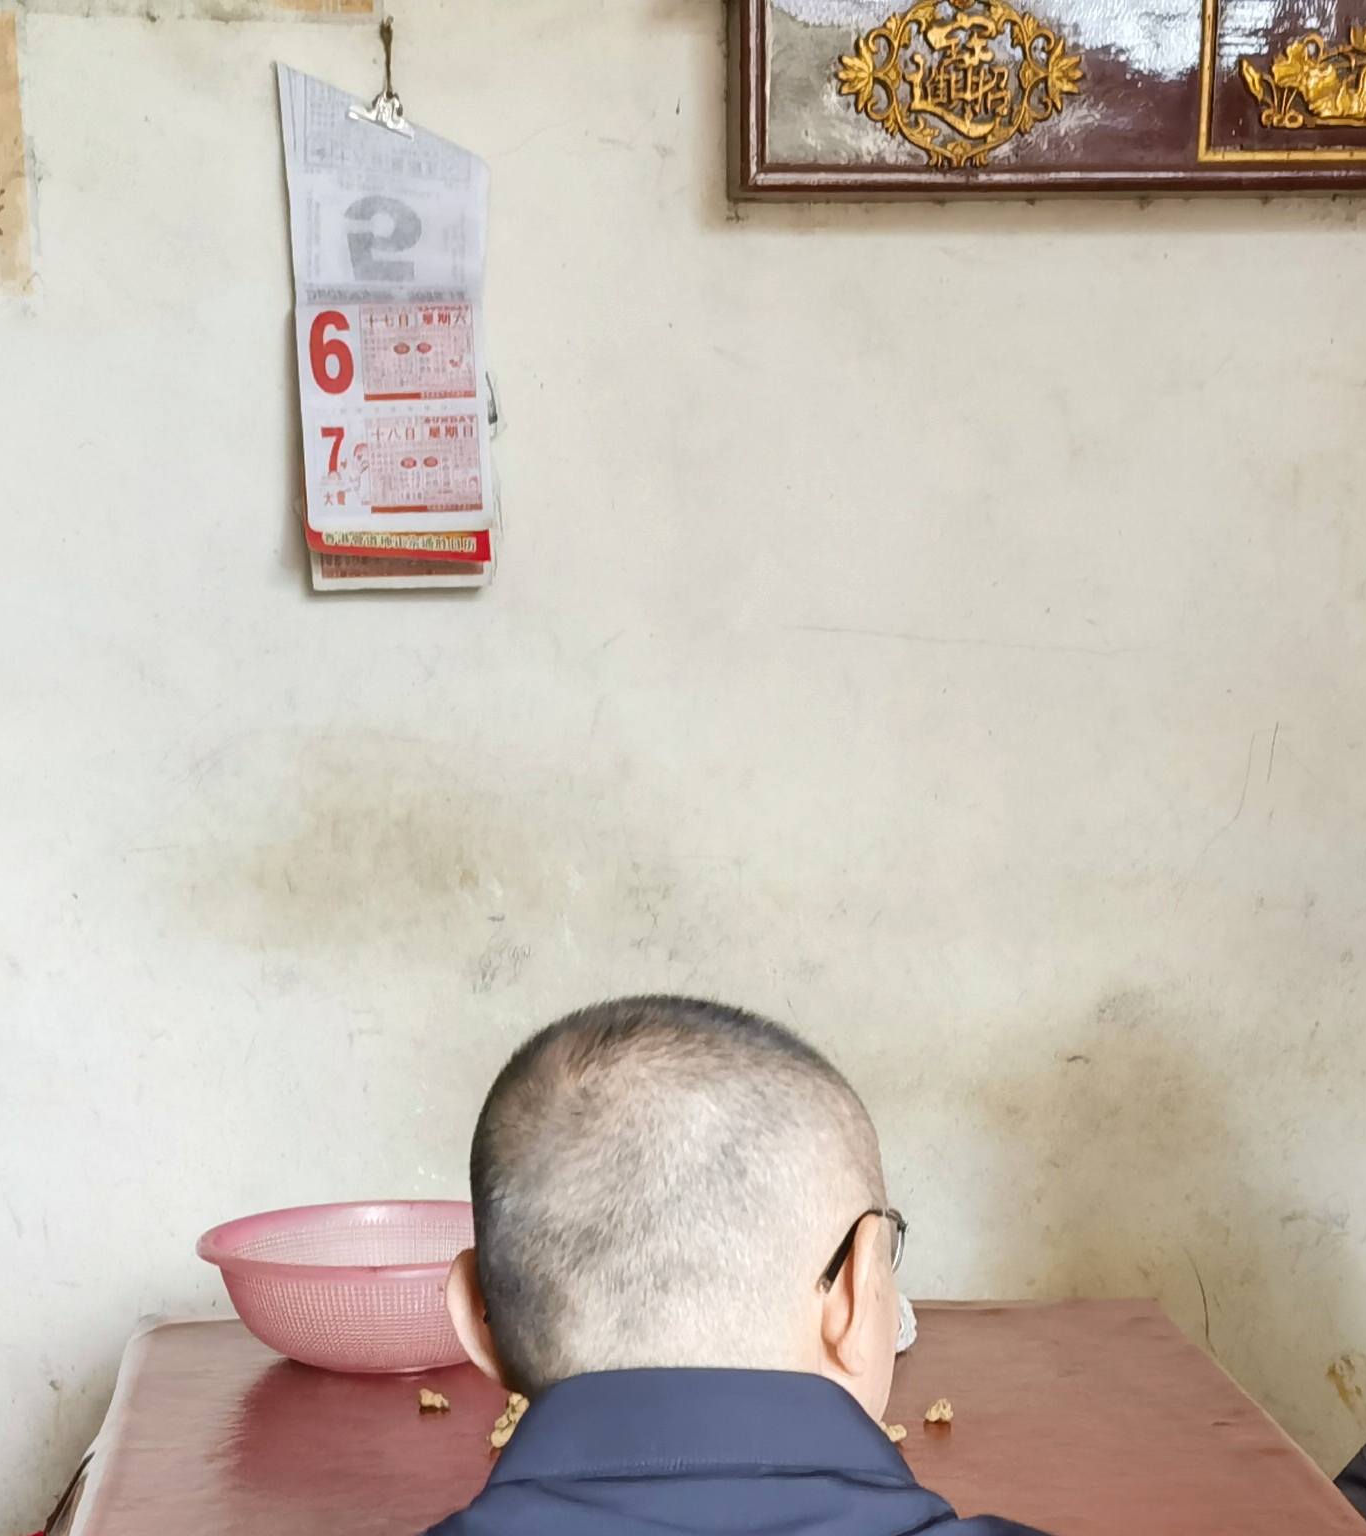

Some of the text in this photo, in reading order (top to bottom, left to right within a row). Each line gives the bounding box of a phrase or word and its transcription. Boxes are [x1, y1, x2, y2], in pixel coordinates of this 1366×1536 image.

[422, 312, 467, 327] 星期六
[309, 310, 354, 394] 6
[374, 426, 416, 441] 十八日
[427, 425, 474, 439] 星期日
[321, 427, 345, 474] 7
